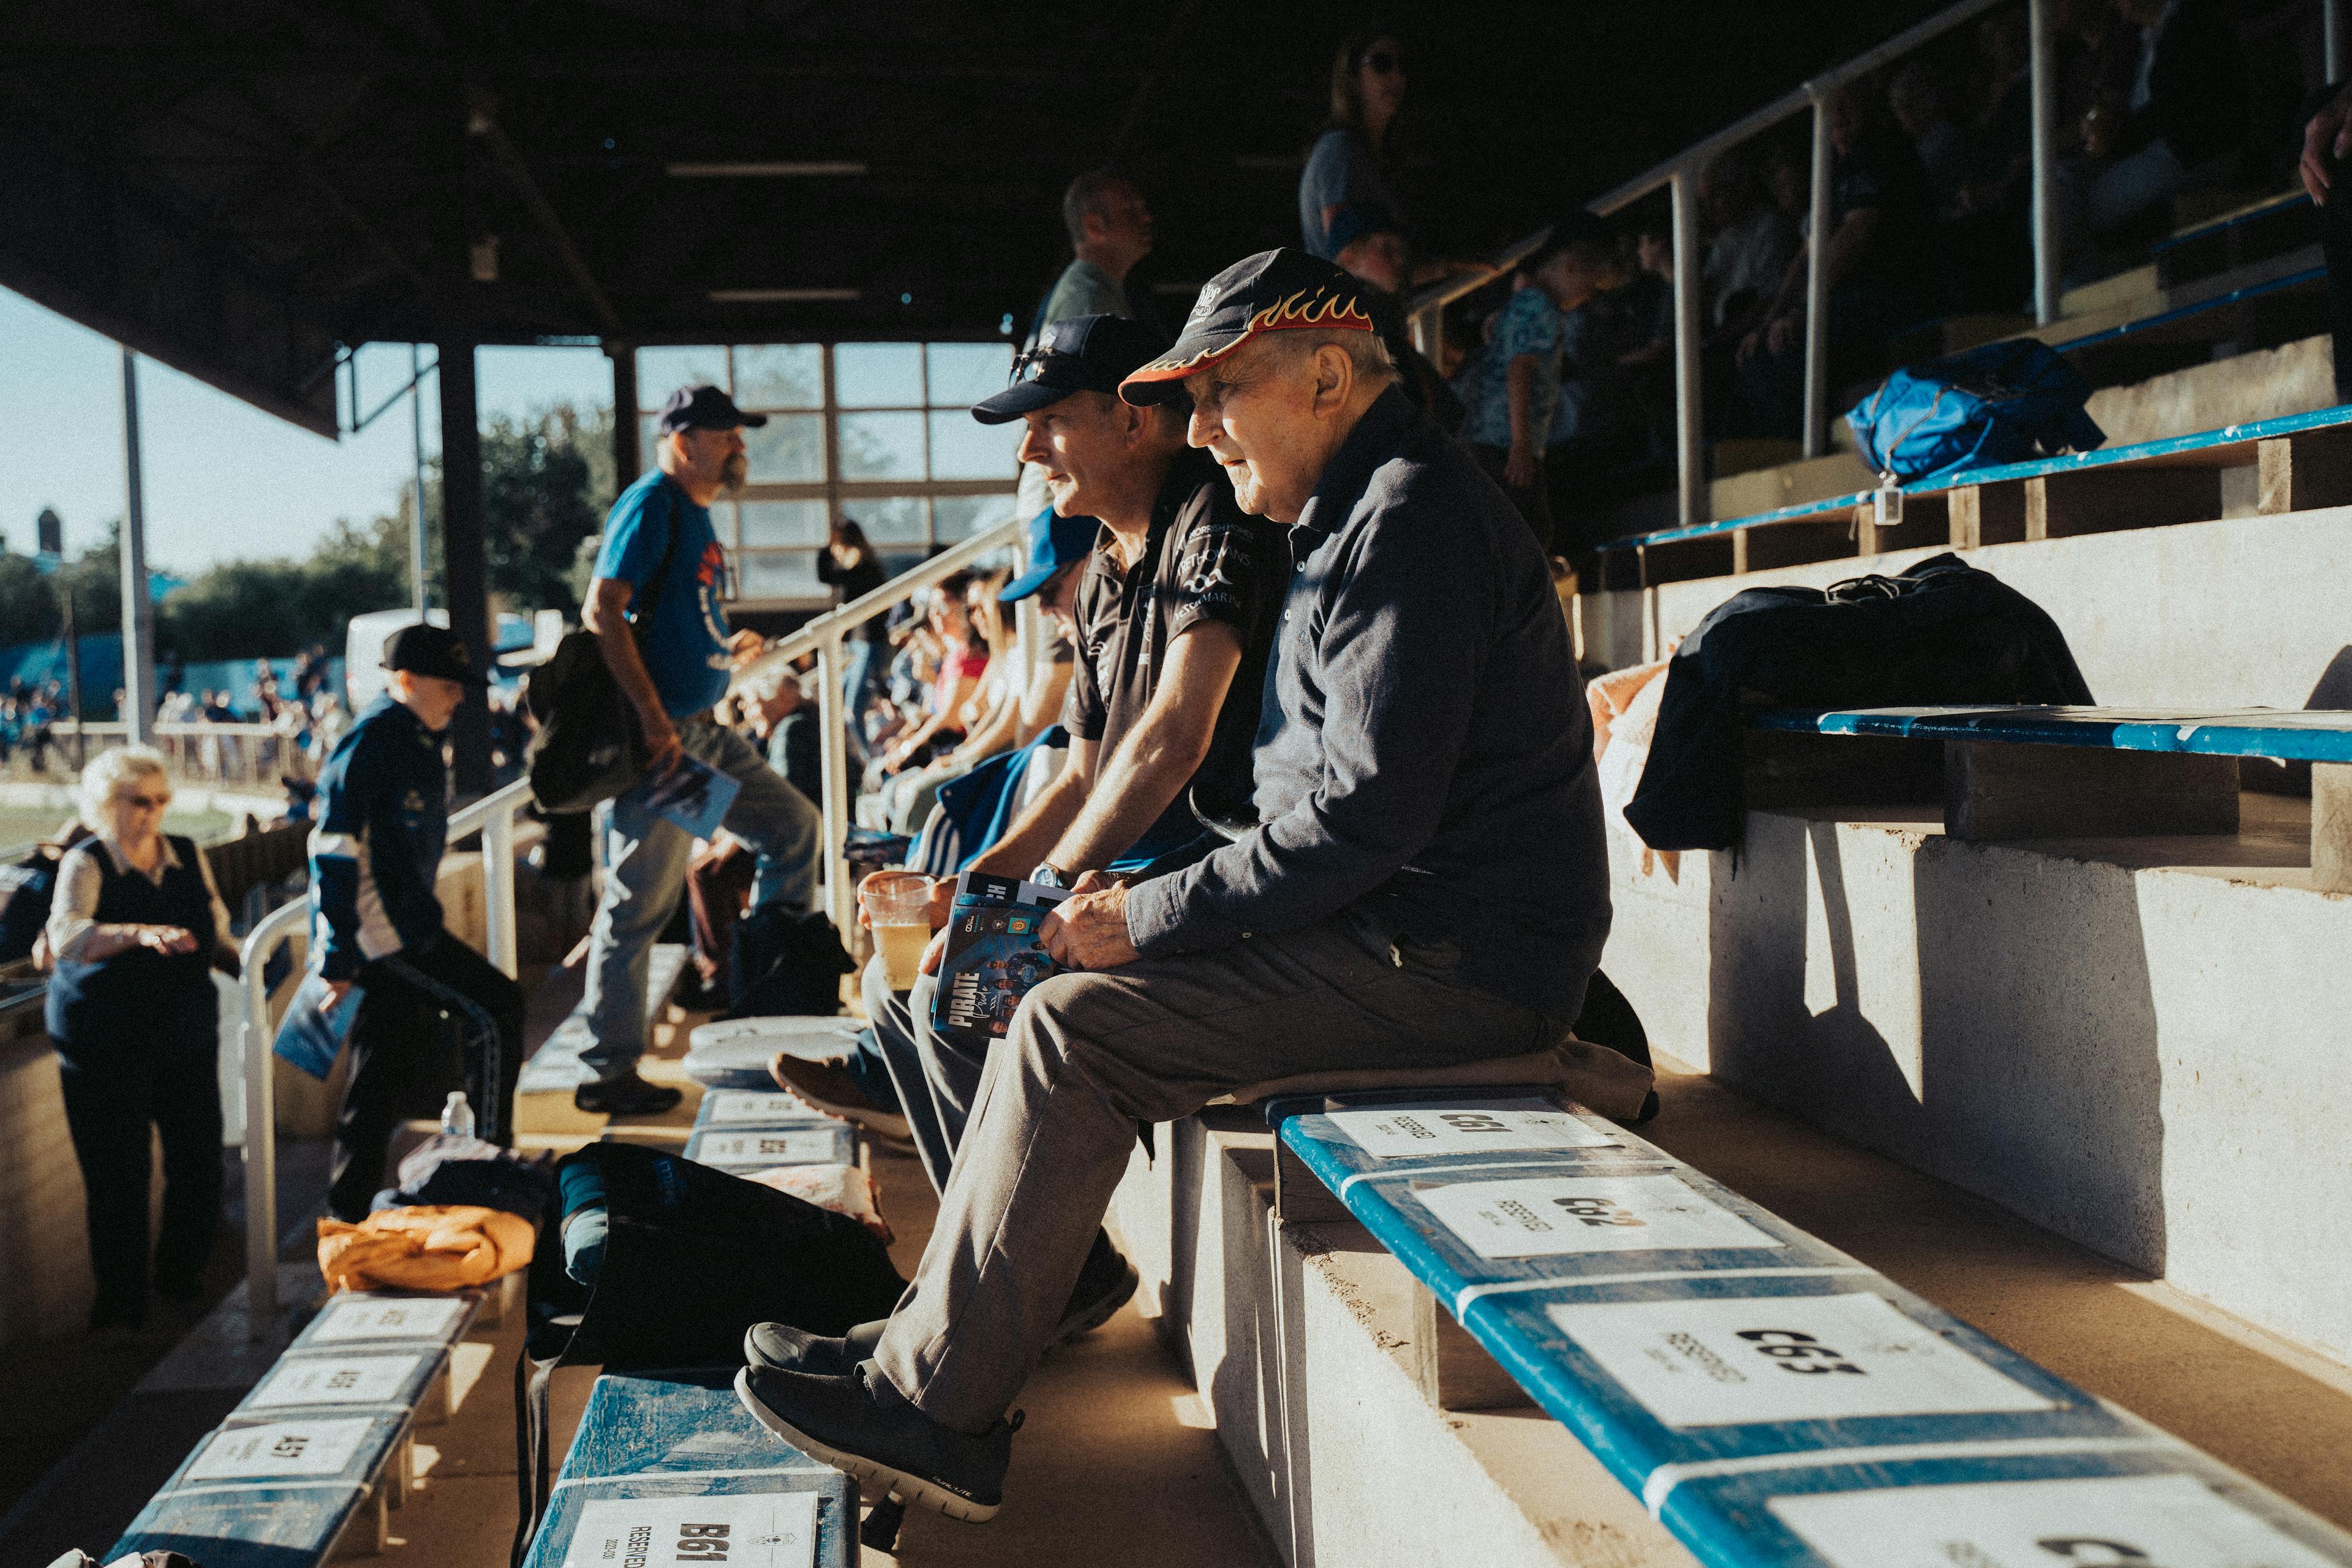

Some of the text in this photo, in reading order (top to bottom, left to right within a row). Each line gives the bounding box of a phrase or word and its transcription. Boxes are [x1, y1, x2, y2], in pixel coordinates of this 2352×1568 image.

[1189, 524, 1225, 539] MORRISH
[1177, 546, 1251, 576] TRETHOWANS
[948, 972, 980, 1028] PIRATE
[968, 986, 992, 1019] Pride
[1390, 1116, 1436, 1139] RESERVED
[1439, 1114, 1513, 1133] C61
[1553, 1197, 1647, 1226] C62
[1735, 1329, 1868, 1375] C63
[603, 1539, 619, 1559] 2023-030
[624, 1526, 652, 1568] RESERVED
[676, 1523, 730, 1561] B61
